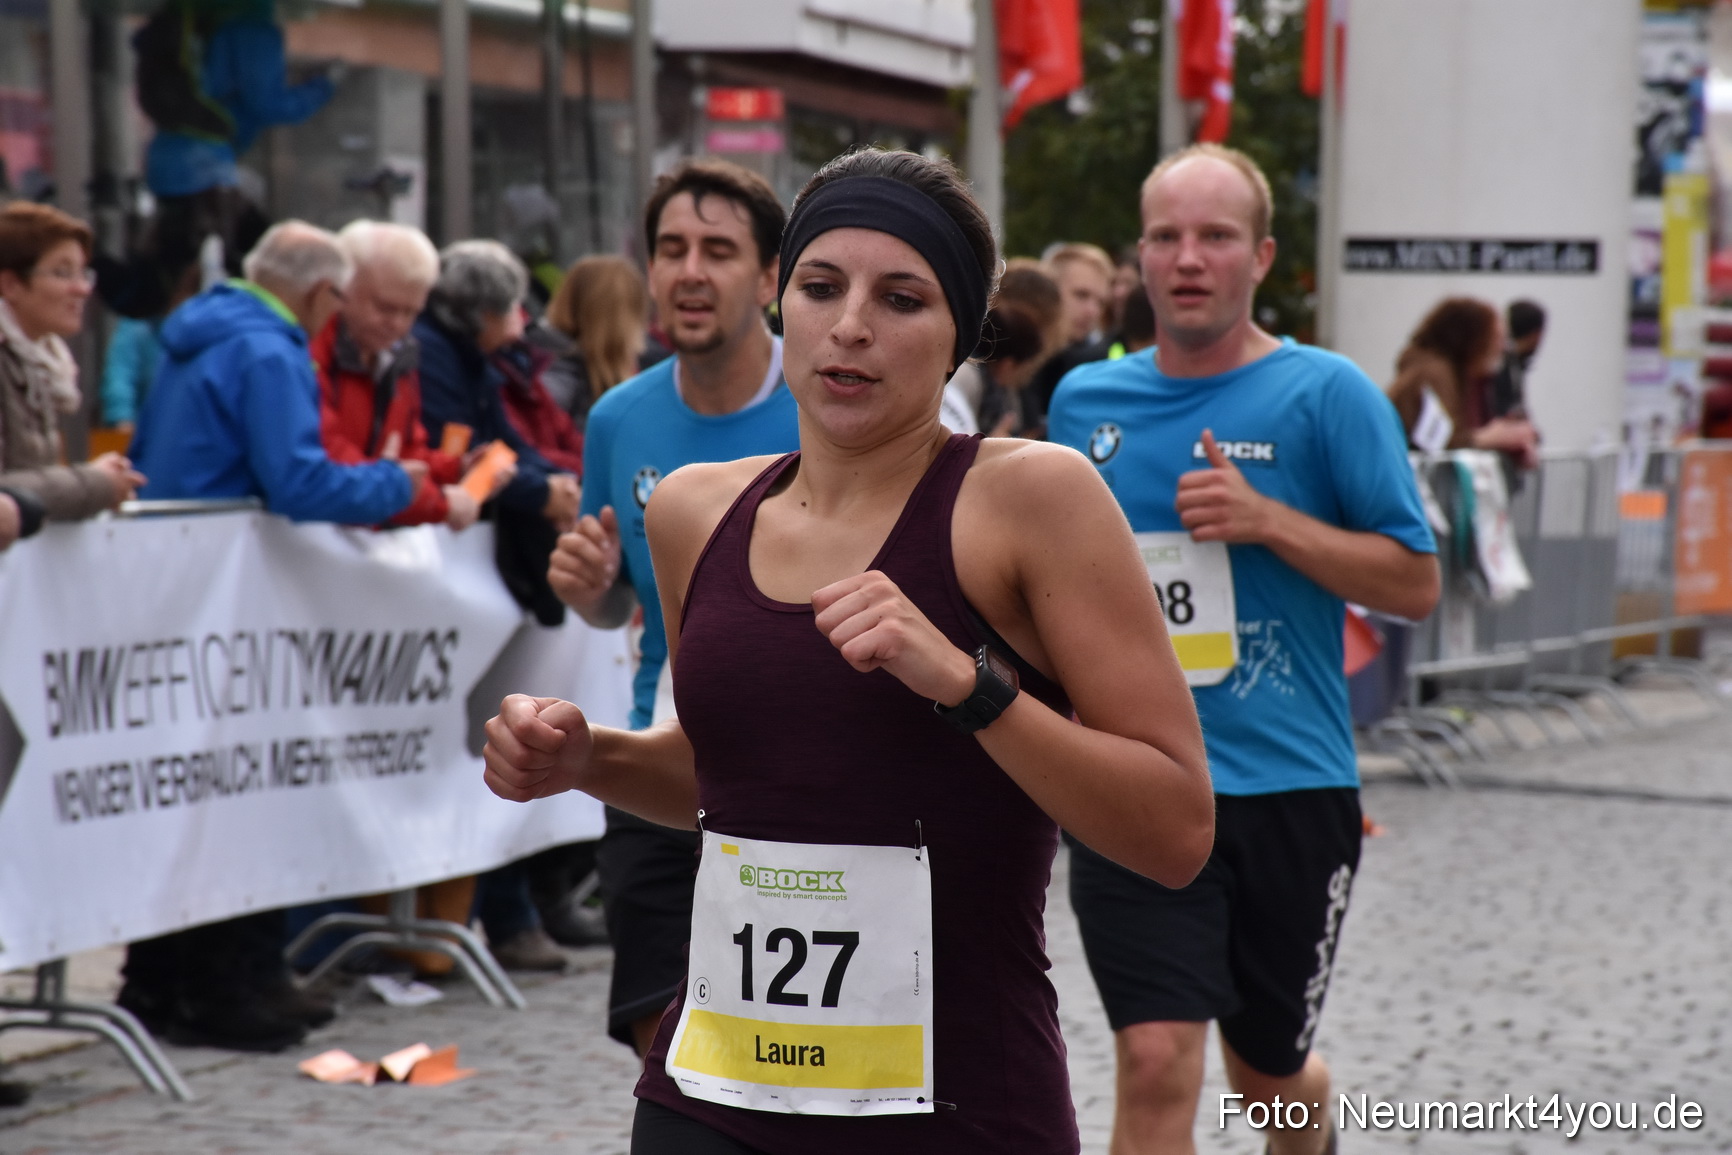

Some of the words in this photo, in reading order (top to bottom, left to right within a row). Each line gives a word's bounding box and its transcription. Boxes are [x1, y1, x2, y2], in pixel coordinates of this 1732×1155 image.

[757, 867, 846, 893] BOCK
[757, 889, 781, 898] inspired
[782, 891, 791, 900] by
[814, 893, 848, 902] concepts
[733, 923, 860, 1008] 127
[699, 984, 706, 999] C
[755, 1034, 826, 1067] Laura
